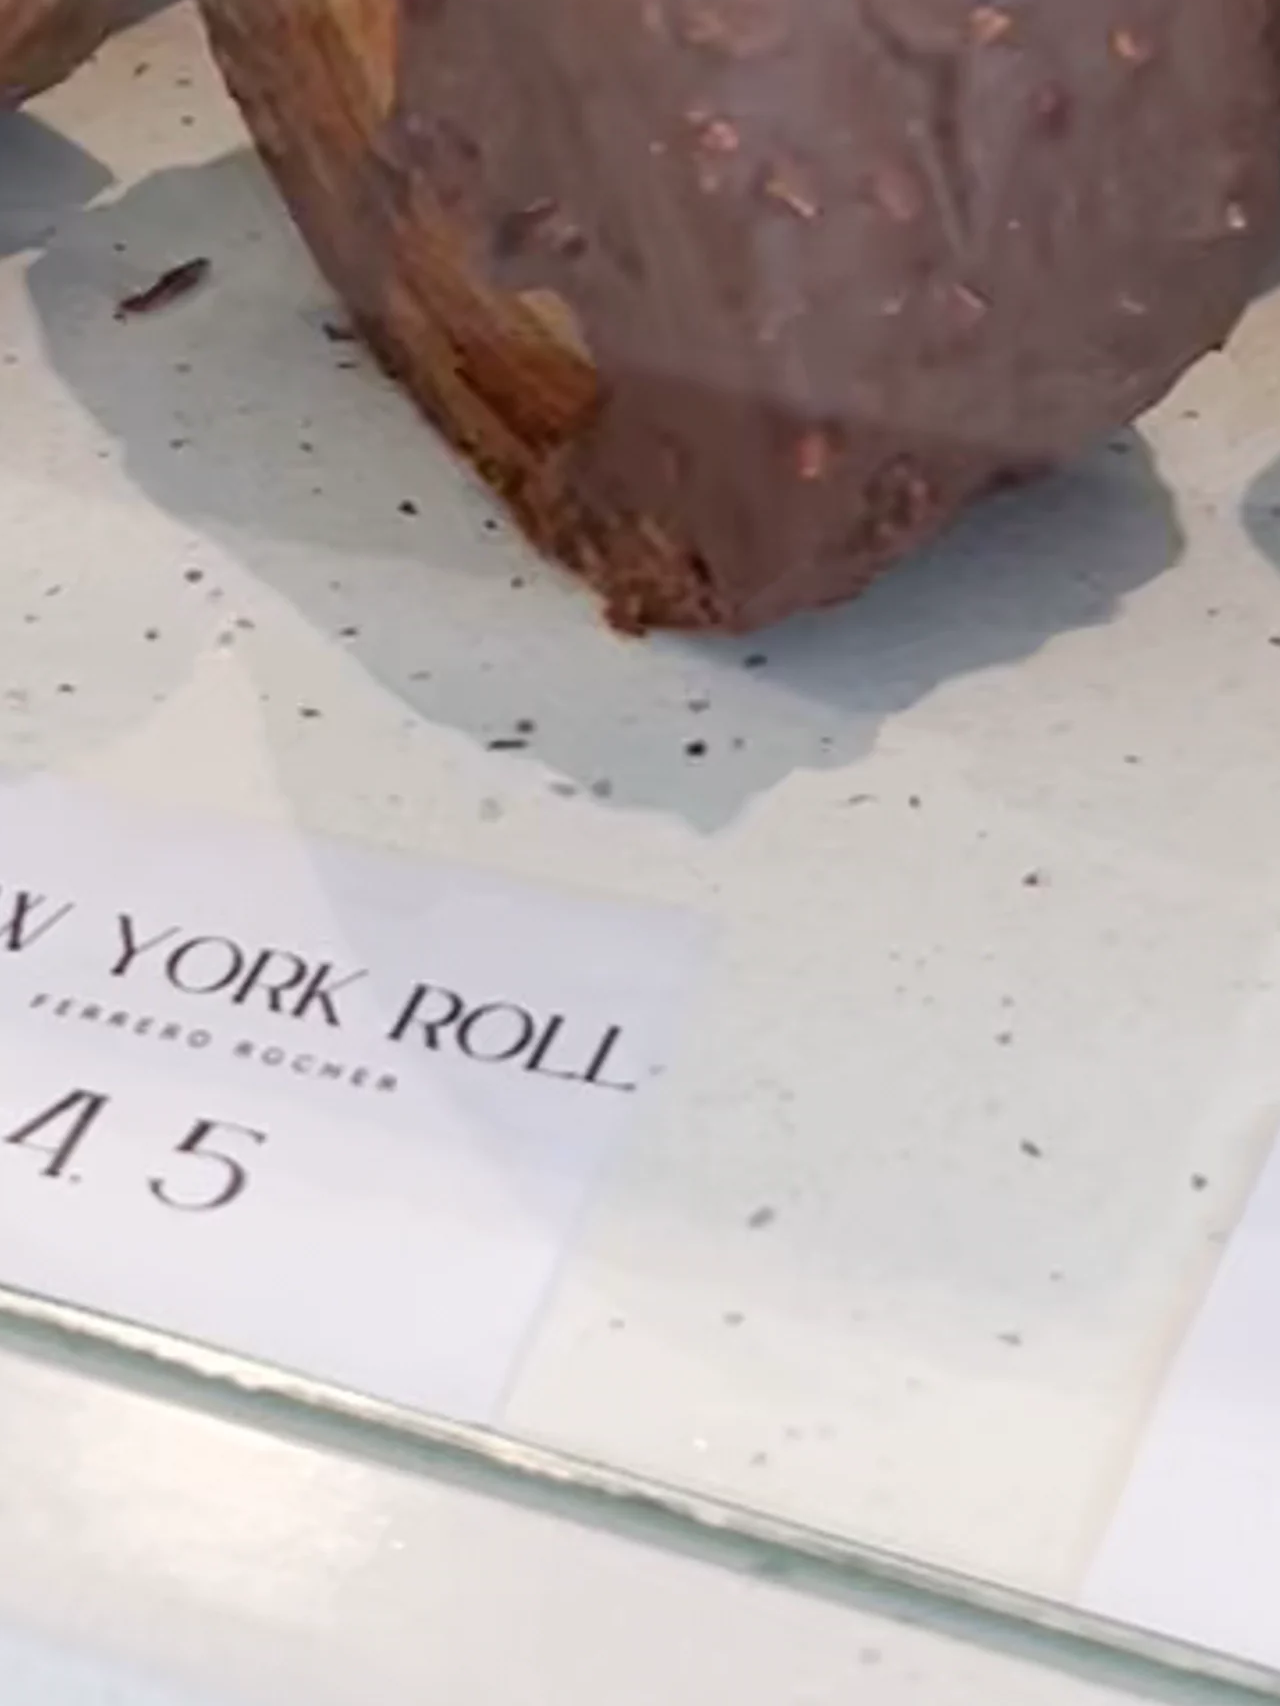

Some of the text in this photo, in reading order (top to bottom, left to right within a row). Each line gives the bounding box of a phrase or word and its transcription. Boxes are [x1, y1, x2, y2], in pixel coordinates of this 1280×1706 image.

[28, 992, 398, 1093] FERRERO ROCHER
[108, 912, 369, 1028] YORK
[385, 982, 637, 1093] ROLL
